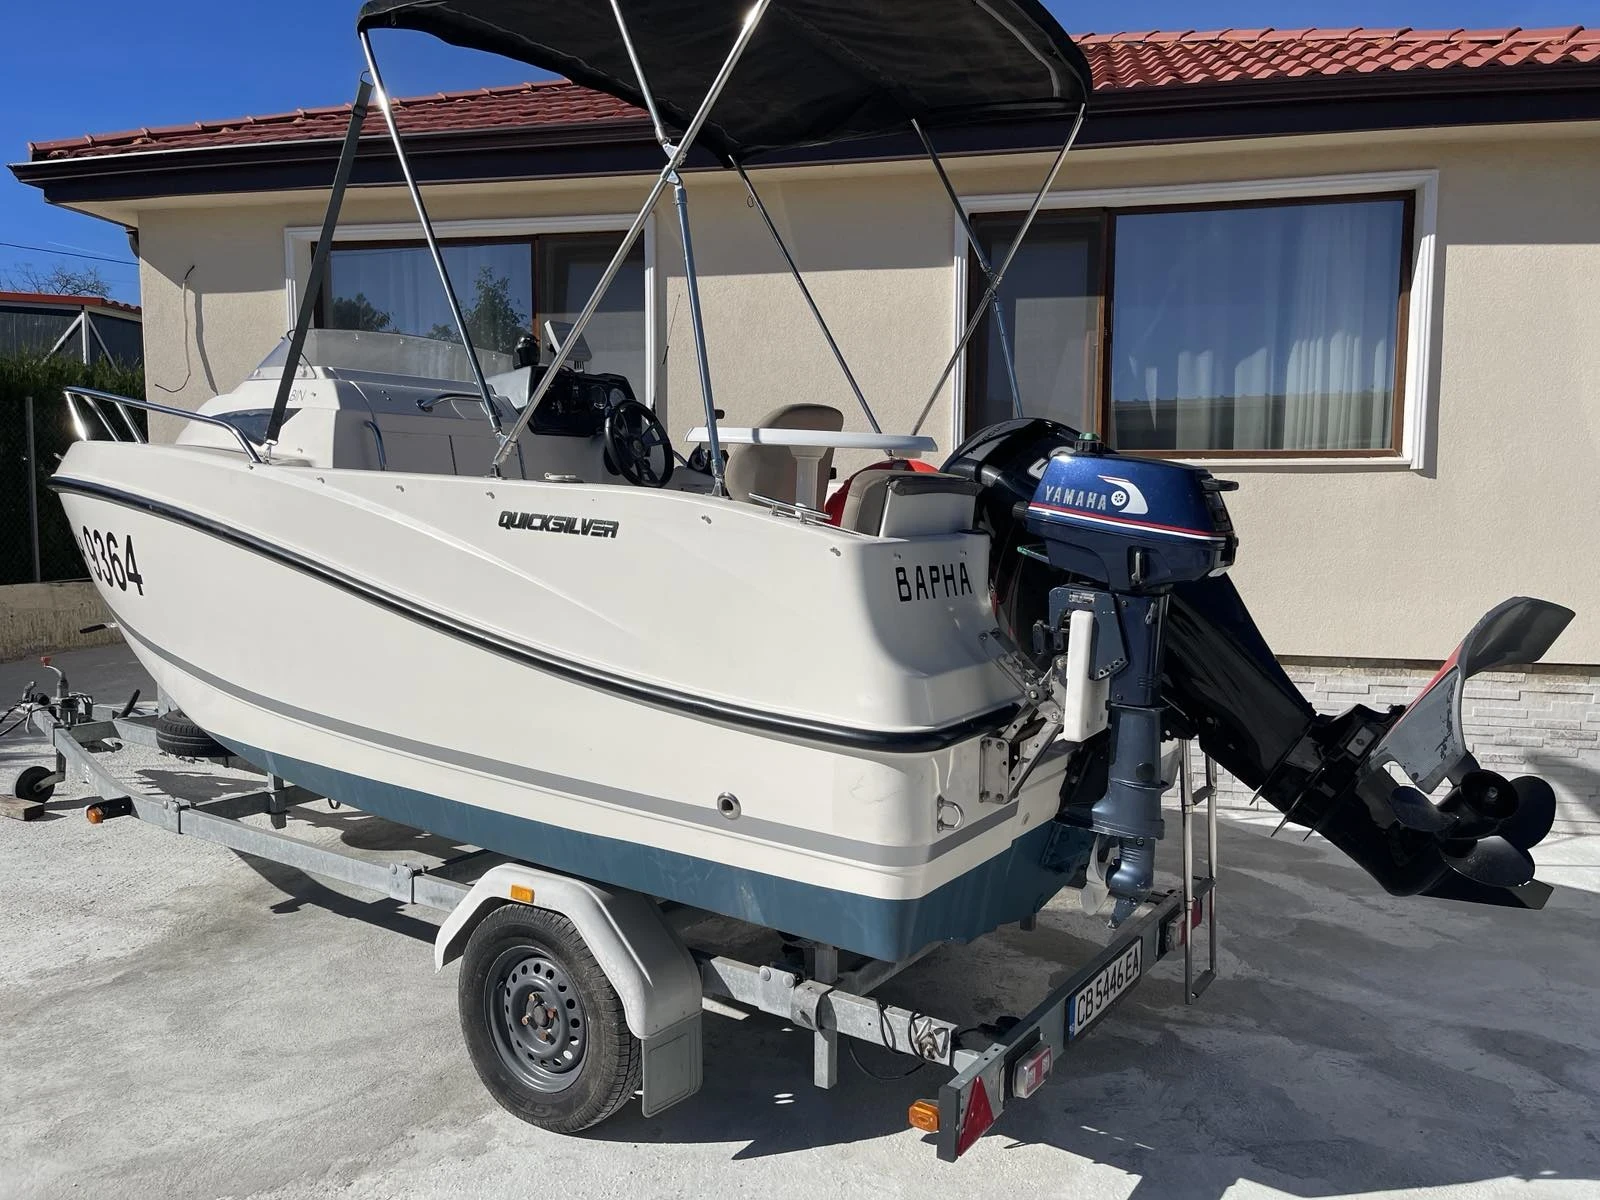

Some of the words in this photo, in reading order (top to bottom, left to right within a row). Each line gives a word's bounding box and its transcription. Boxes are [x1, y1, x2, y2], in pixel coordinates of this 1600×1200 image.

[1044, 484, 1107, 511] YAMAHA
[497, 510, 620, 539] QUICKSILVER
[82, 524, 144, 597] 9364
[895, 561, 973, 602] ВАРНА
